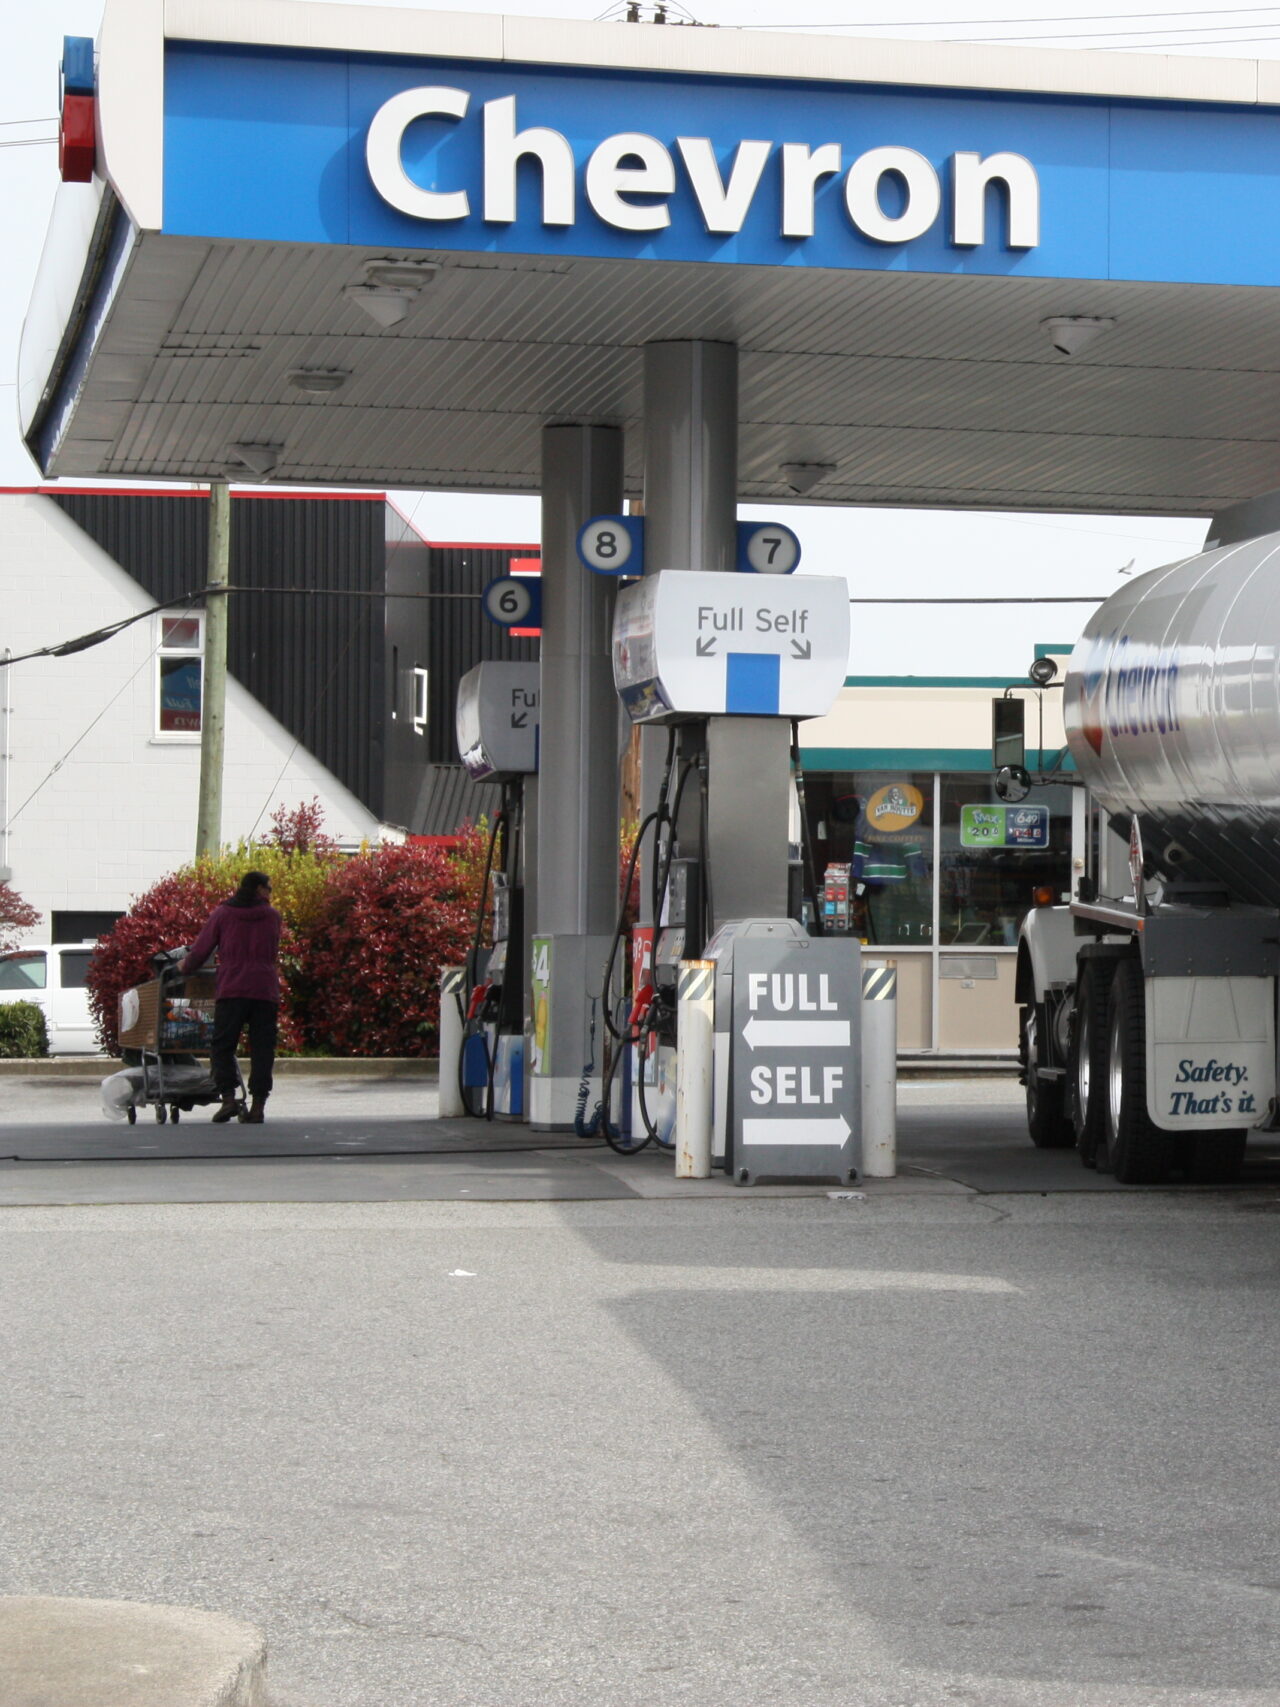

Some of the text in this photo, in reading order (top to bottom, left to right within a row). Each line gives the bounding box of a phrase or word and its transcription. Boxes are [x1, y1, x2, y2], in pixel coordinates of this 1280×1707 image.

[365, 86, 1040, 249] Chevron
[595, 531, 618, 558] 8
[762, 538, 782, 564] 7
[500, 590, 518, 613] 6
[698, 607, 809, 634] Full Self
[1017, 812, 1038, 824] 649
[748, 973, 838, 1011] FULL
[750, 1066, 843, 1105] SELF
[1176, 1058, 1249, 1087] Safety.
[1169, 1092, 1257, 1115] That's it.
